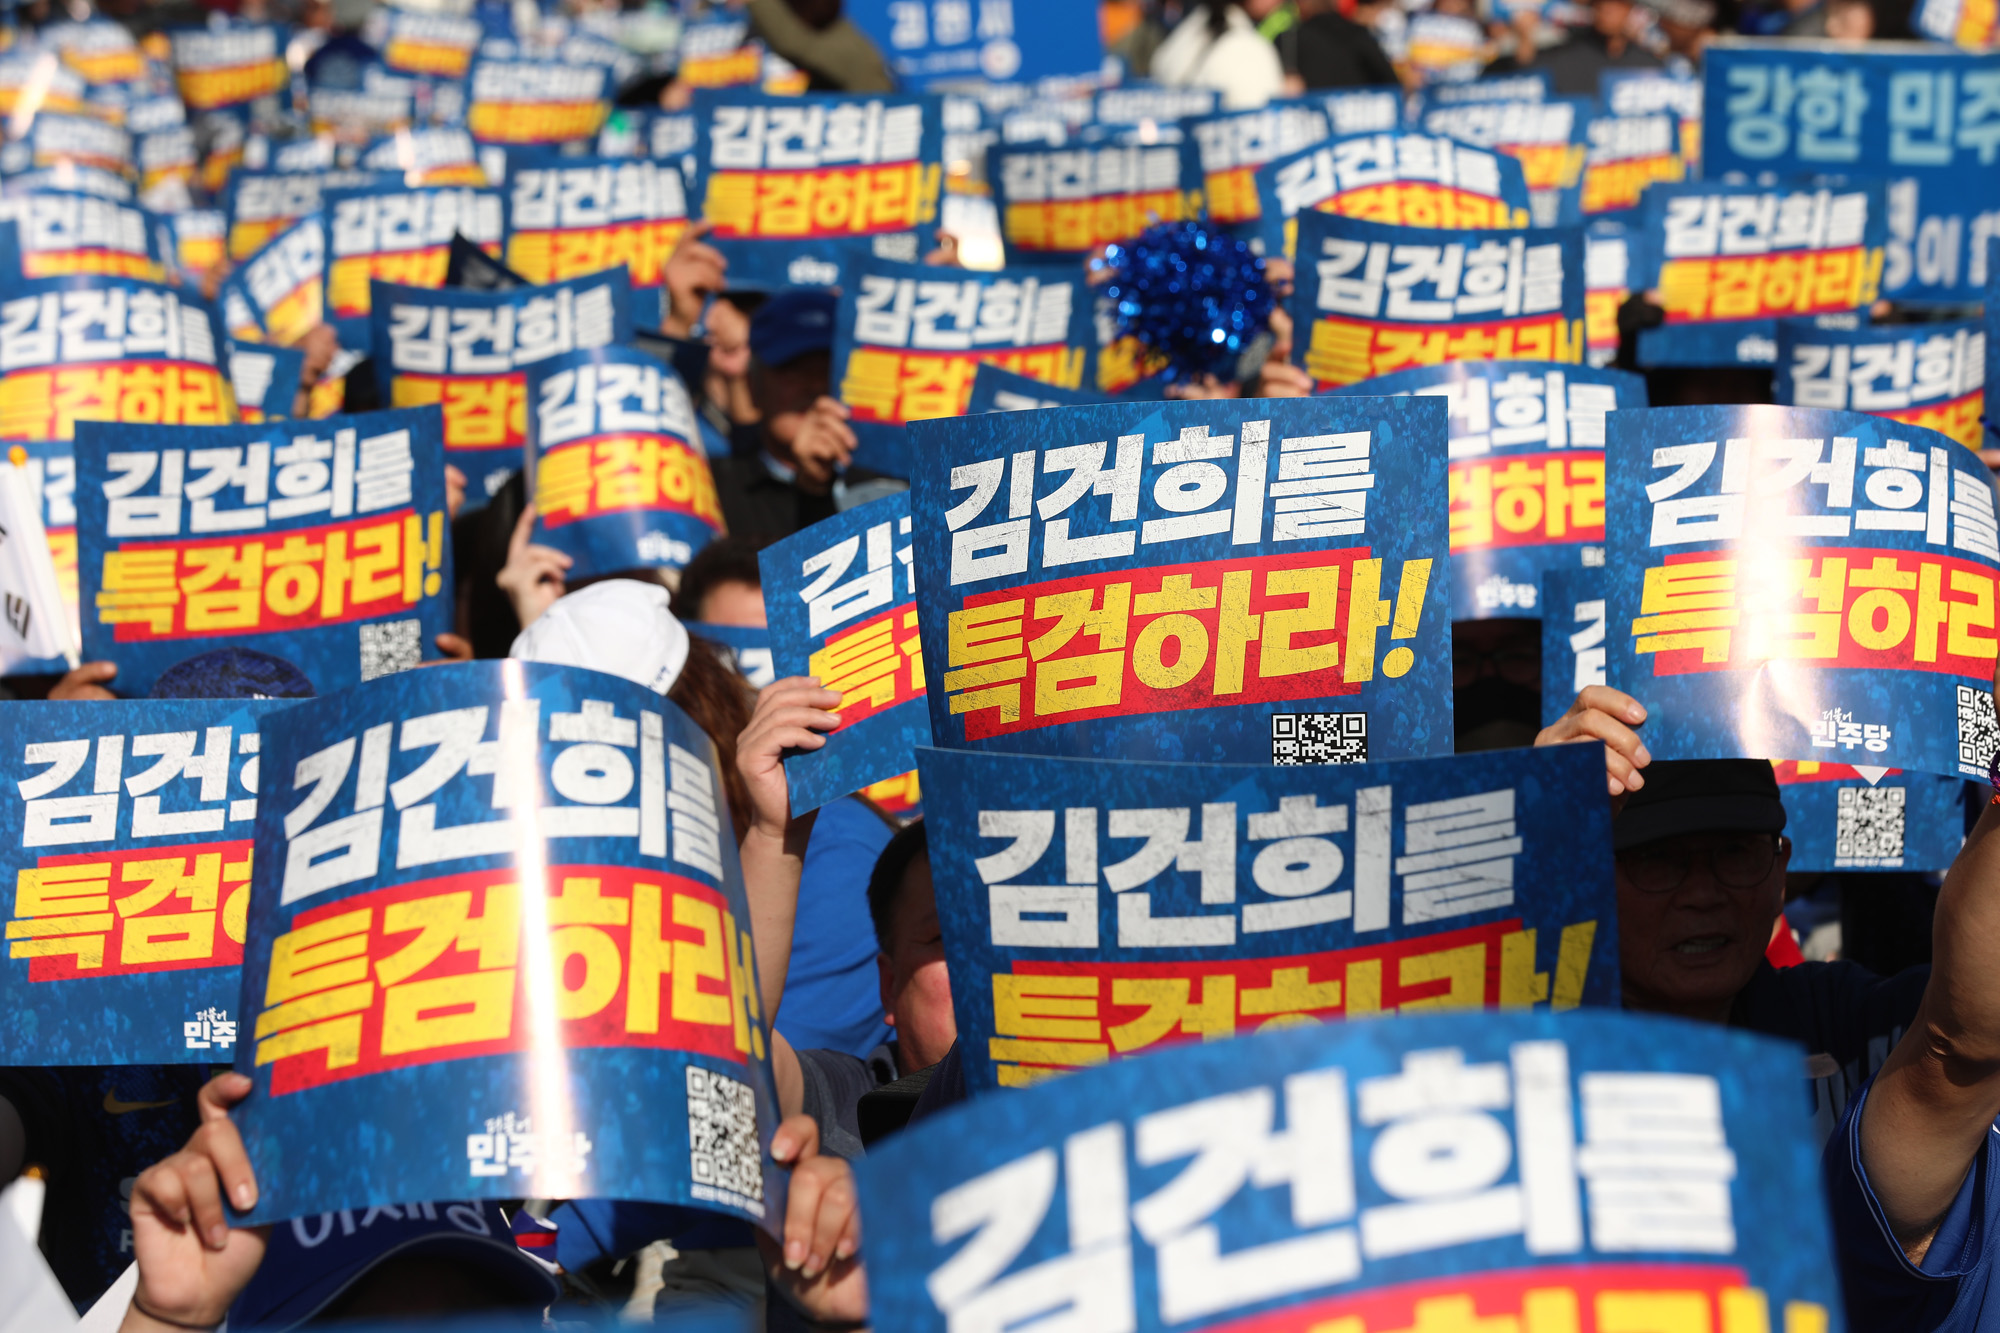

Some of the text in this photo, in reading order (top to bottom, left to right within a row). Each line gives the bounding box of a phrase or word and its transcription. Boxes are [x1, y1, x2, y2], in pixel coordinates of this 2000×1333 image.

[712, 101, 922, 168] 김건희를
[1727, 65, 1867, 160] 강한
[704, 161, 942, 236] 특검하라!
[1664, 189, 1868, 257] 김건희를
[854, 275, 1073, 350] 김건희를
[1317, 236, 1563, 321] 김건희를
[1658, 247, 1885, 319] 특검하라!
[0, 287, 217, 371] 김건희를
[389, 283, 614, 374] 김건희를
[1392, 371, 1617, 458] 건희를
[102, 428, 414, 537] 김건희를
[945, 419, 1375, 586] 김건희를
[1645, 436, 2000, 563] 김건희를
[96, 510, 445, 634] 특검하라!
[799, 513, 916, 638] 김
[944, 557, 1434, 724] 특검하라!
[1810, 720, 1892, 753] 민주당
[281, 698, 724, 907] 김건희를
[975, 786, 1523, 948] 김건희를
[254, 877, 766, 1070] 특검하라!
[925, 1040, 1737, 1333] 김건희를
